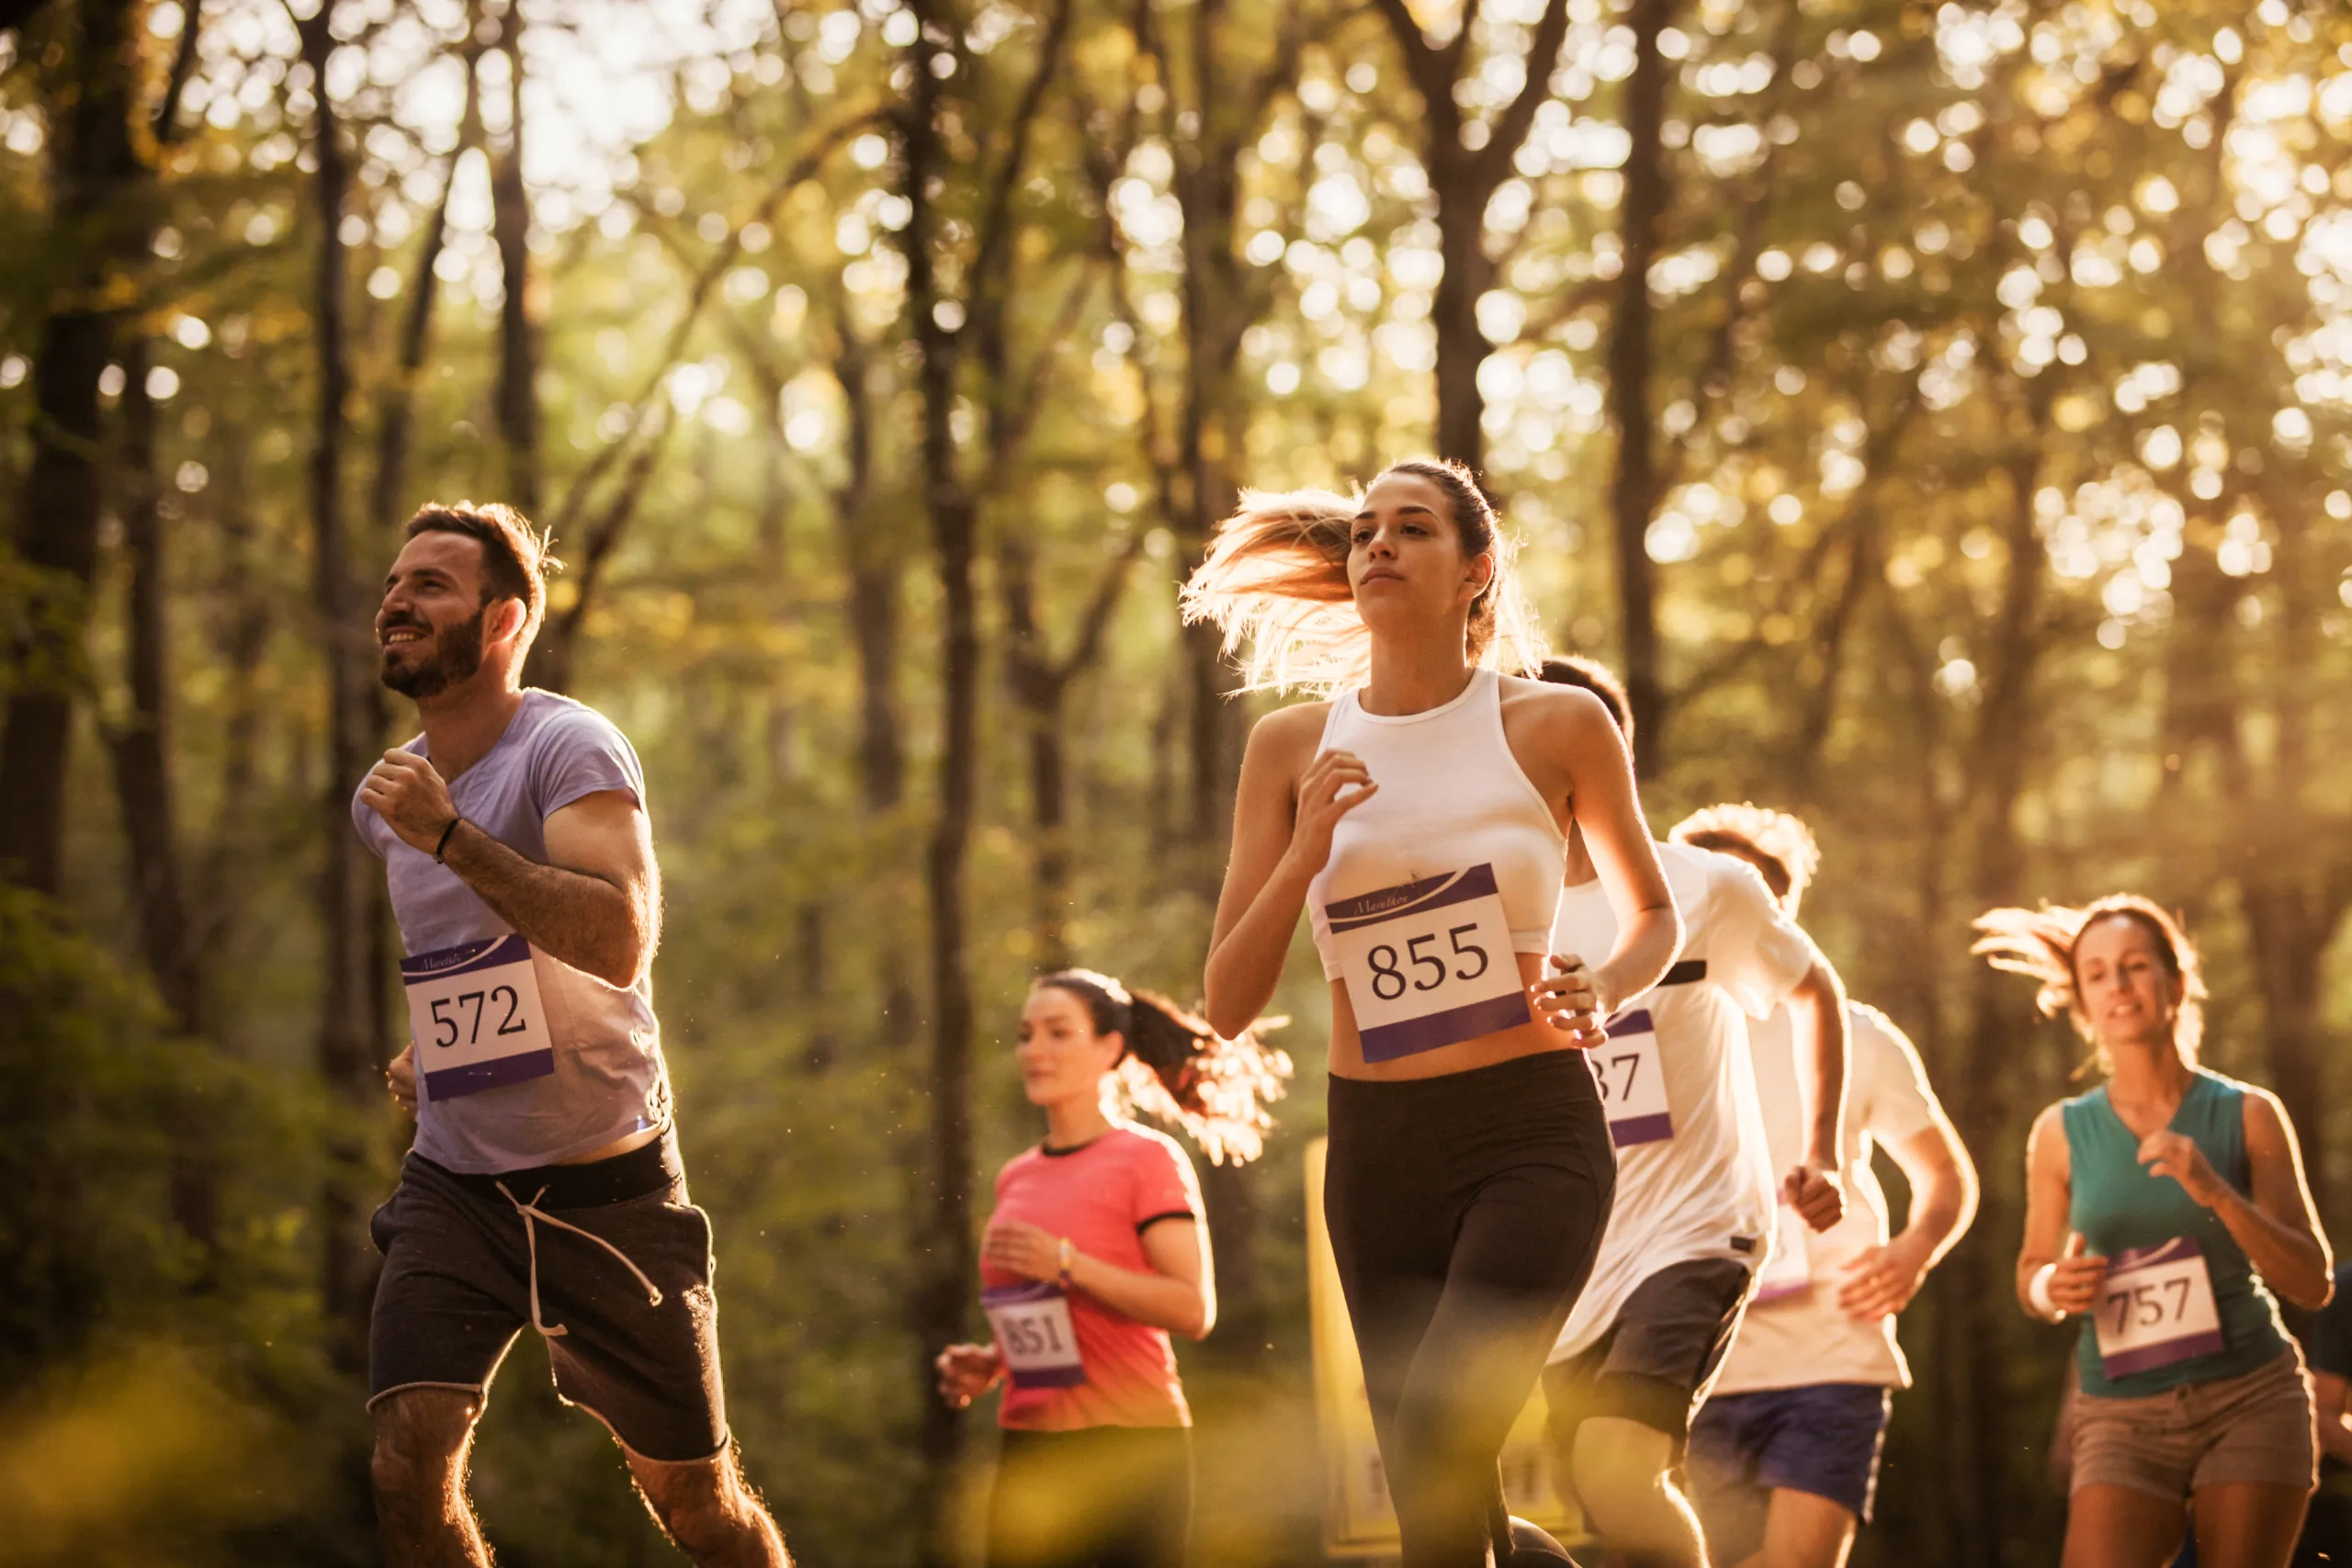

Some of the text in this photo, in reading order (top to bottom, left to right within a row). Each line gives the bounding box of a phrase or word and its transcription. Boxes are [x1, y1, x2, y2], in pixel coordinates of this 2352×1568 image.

[1367, 922, 1488, 1000] 855
[430, 985, 526, 1047] 572
[2107, 1275, 2191, 1337] 757
